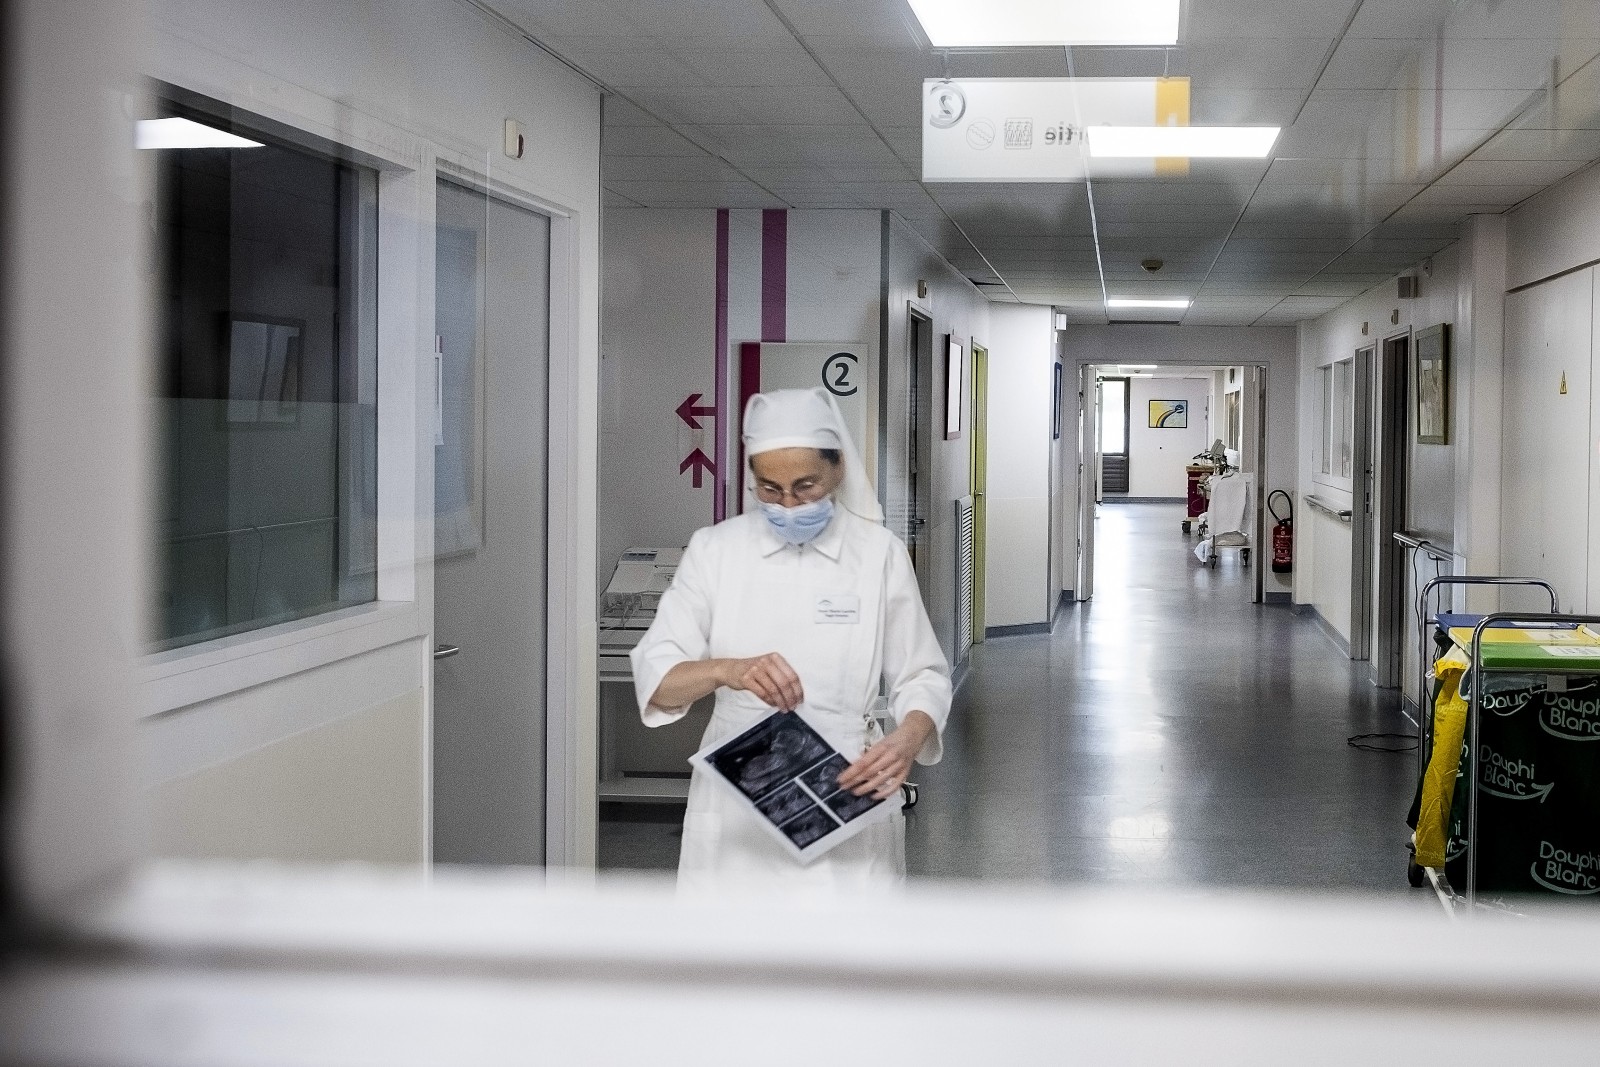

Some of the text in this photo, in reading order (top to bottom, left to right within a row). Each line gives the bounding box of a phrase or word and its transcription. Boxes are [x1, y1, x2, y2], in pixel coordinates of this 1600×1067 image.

[1479, 744, 1535, 780] Dauphi
[1483, 764, 1526, 795] Blanc
[1545, 860, 1597, 889] Blanc
